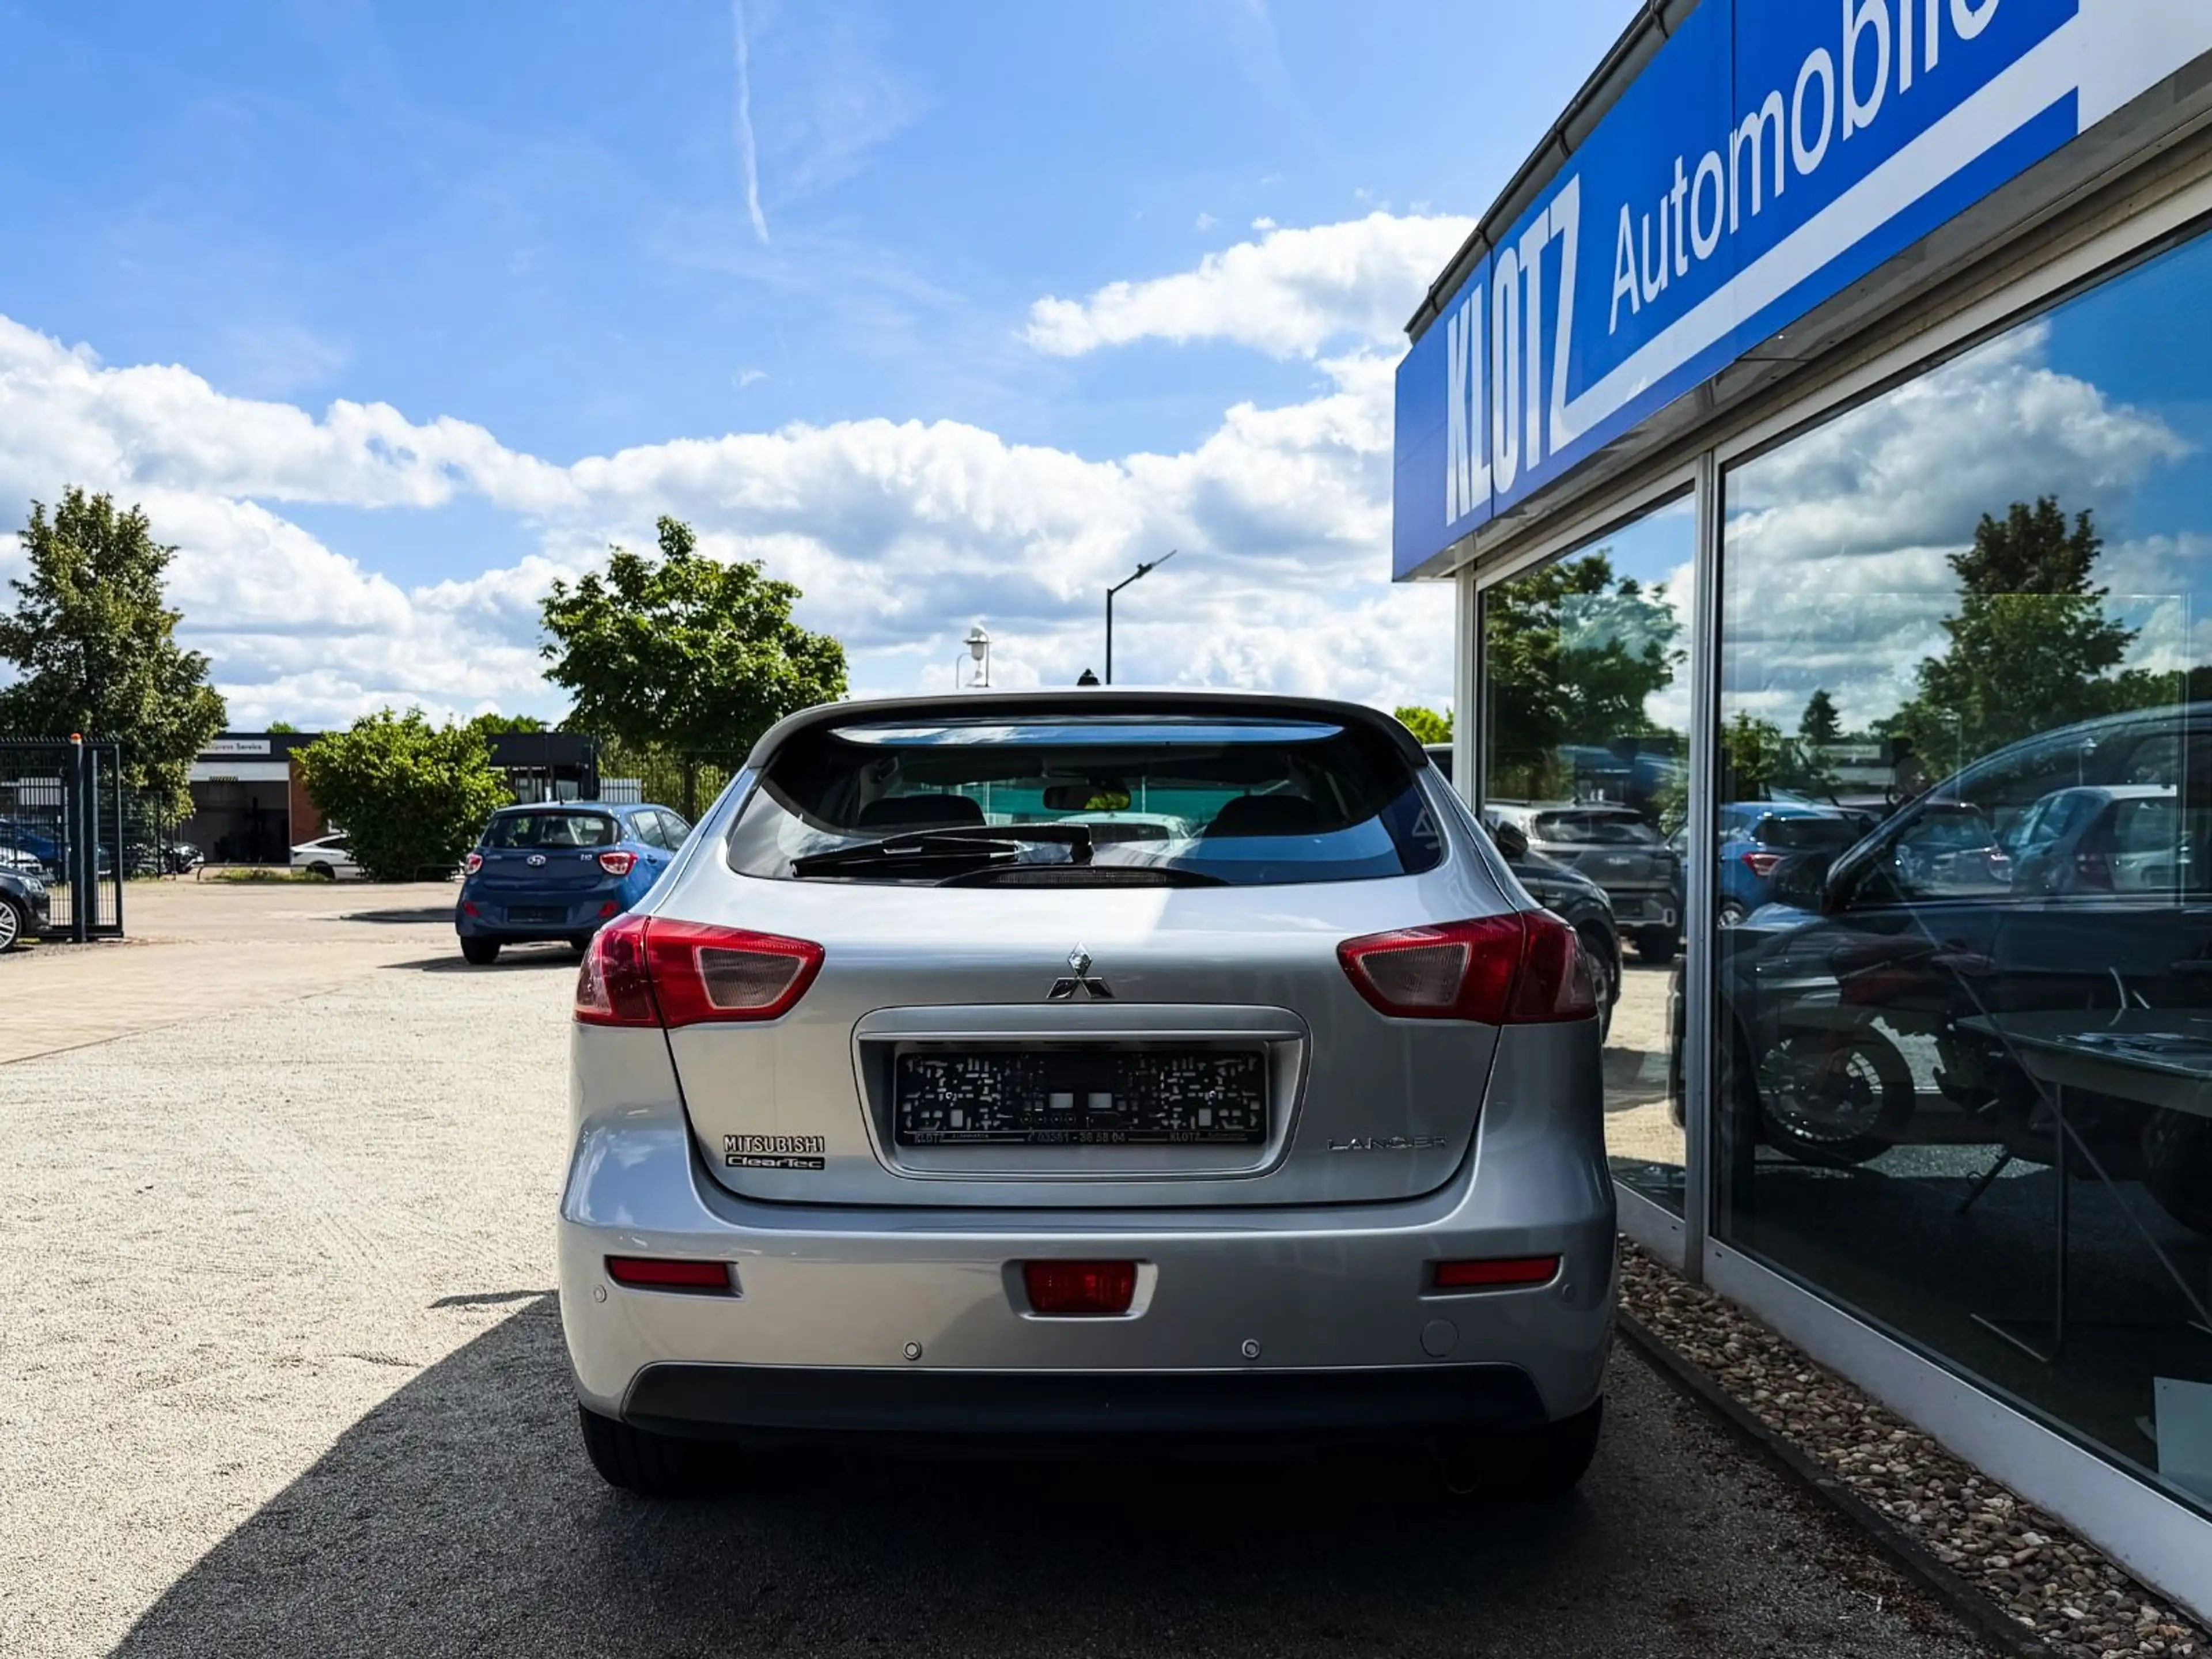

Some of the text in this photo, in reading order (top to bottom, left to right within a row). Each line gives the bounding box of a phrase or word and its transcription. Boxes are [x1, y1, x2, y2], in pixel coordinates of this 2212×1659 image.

[1446, 0, 2000, 527] KLOTZ Automobi
[724, 1135, 825, 1153] MITSUBISHI
[1327, 1135, 1448, 1150] LANCER
[727, 1156, 823, 1169] ClearTec
